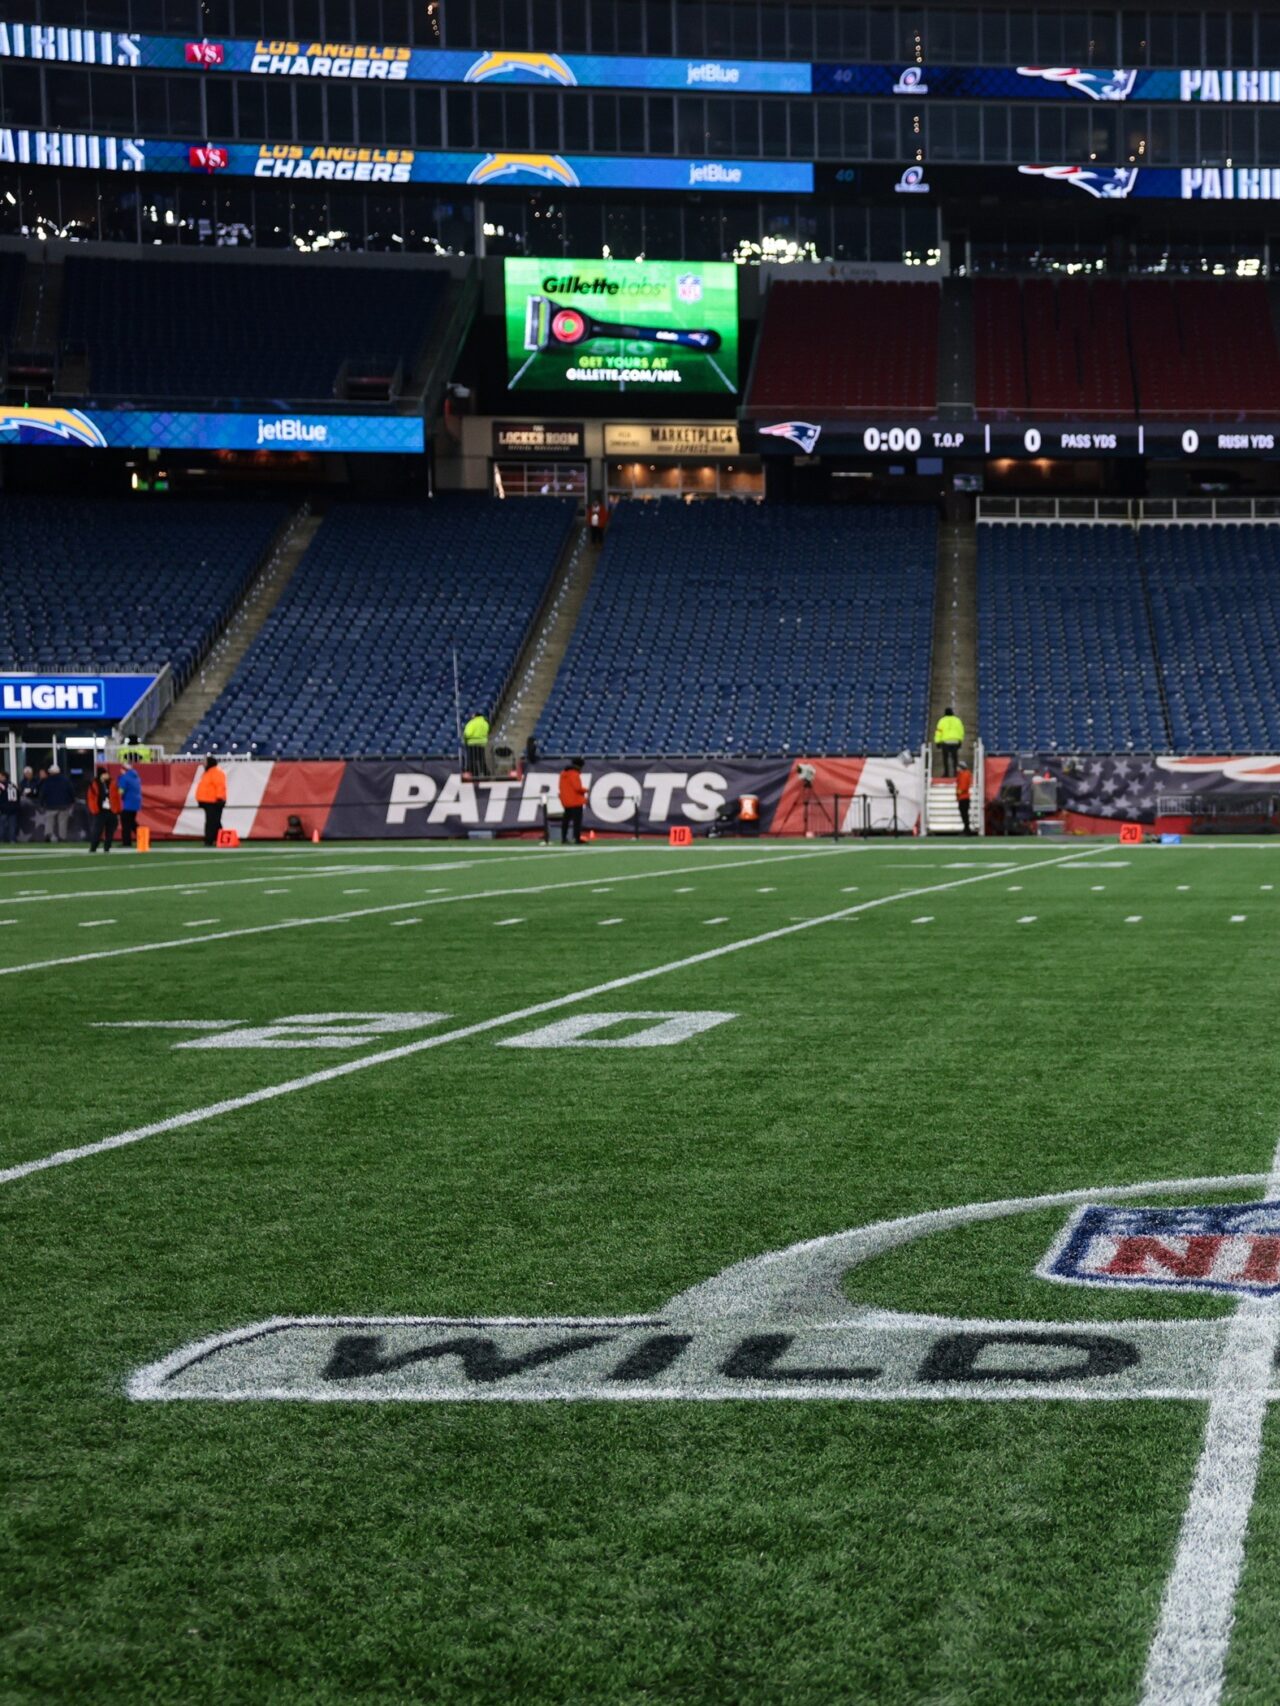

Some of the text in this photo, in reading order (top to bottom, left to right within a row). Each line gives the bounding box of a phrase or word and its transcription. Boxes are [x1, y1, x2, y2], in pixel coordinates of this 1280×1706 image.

[255, 40, 411, 61] LOS ANGELES
[250, 55, 409, 80] CHARGERS
[686, 62, 740, 84] jetBlue
[259, 145, 414, 164] LOS ANGELES
[254, 158, 411, 183] CHARGERS
[689, 161, 742, 184] jetBlue
[579, 356, 668, 369] GET YOURS AT
[566, 367, 682, 383] GILLETTE.COM/NFL
[256, 419, 327, 443] jetBlue
[499, 431, 579, 446] LOCKER ROOM
[863, 427, 964, 452] 0:00 T.O.P
[1024, 428, 1117, 452] 0 PASS YDS
[1181, 429, 1275, 453] 0 RUSH YDS
[3, 684, 98, 710] LIGHT
[671, 829, 686, 843] 10
[1121, 826, 1138, 841] 20
[322, 1333, 1141, 1382] WILD
